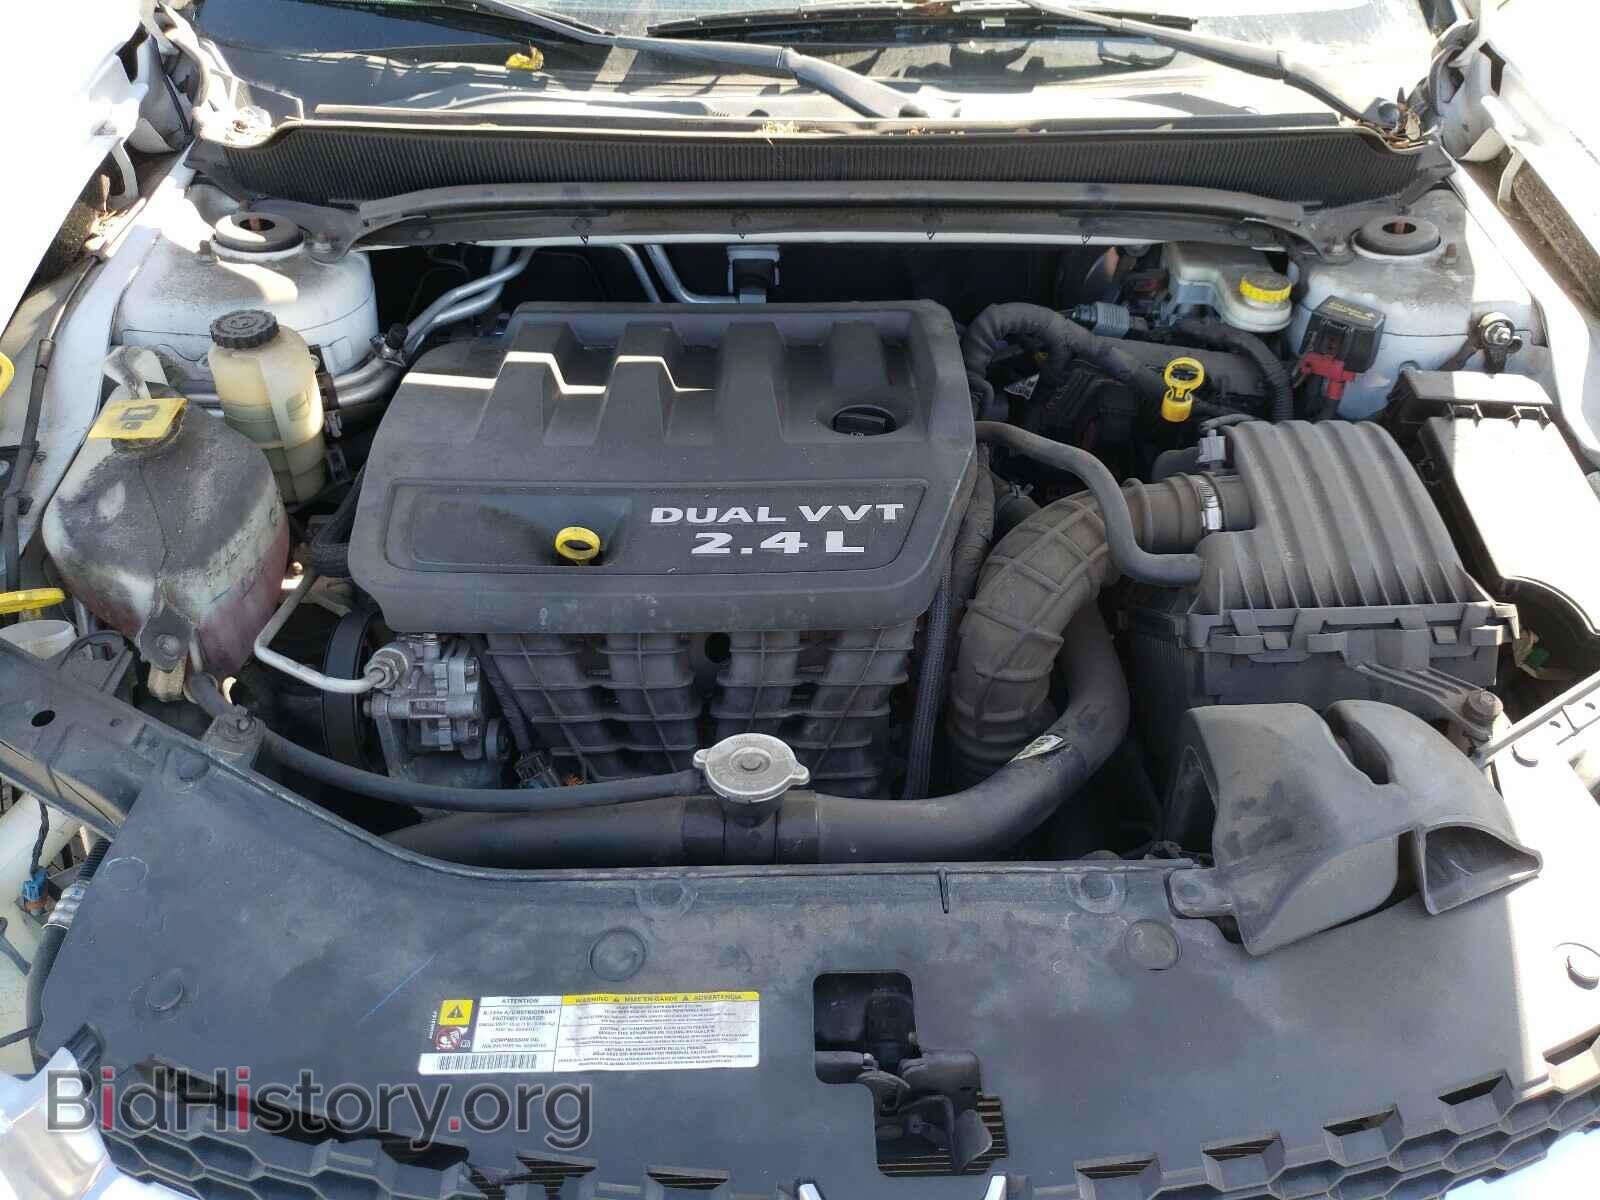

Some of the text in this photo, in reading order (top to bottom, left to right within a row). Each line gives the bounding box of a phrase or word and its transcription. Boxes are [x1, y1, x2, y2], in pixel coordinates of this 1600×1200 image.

[650, 503, 904, 524] DUAL VVT
[691, 530, 865, 555] 2.4 L
